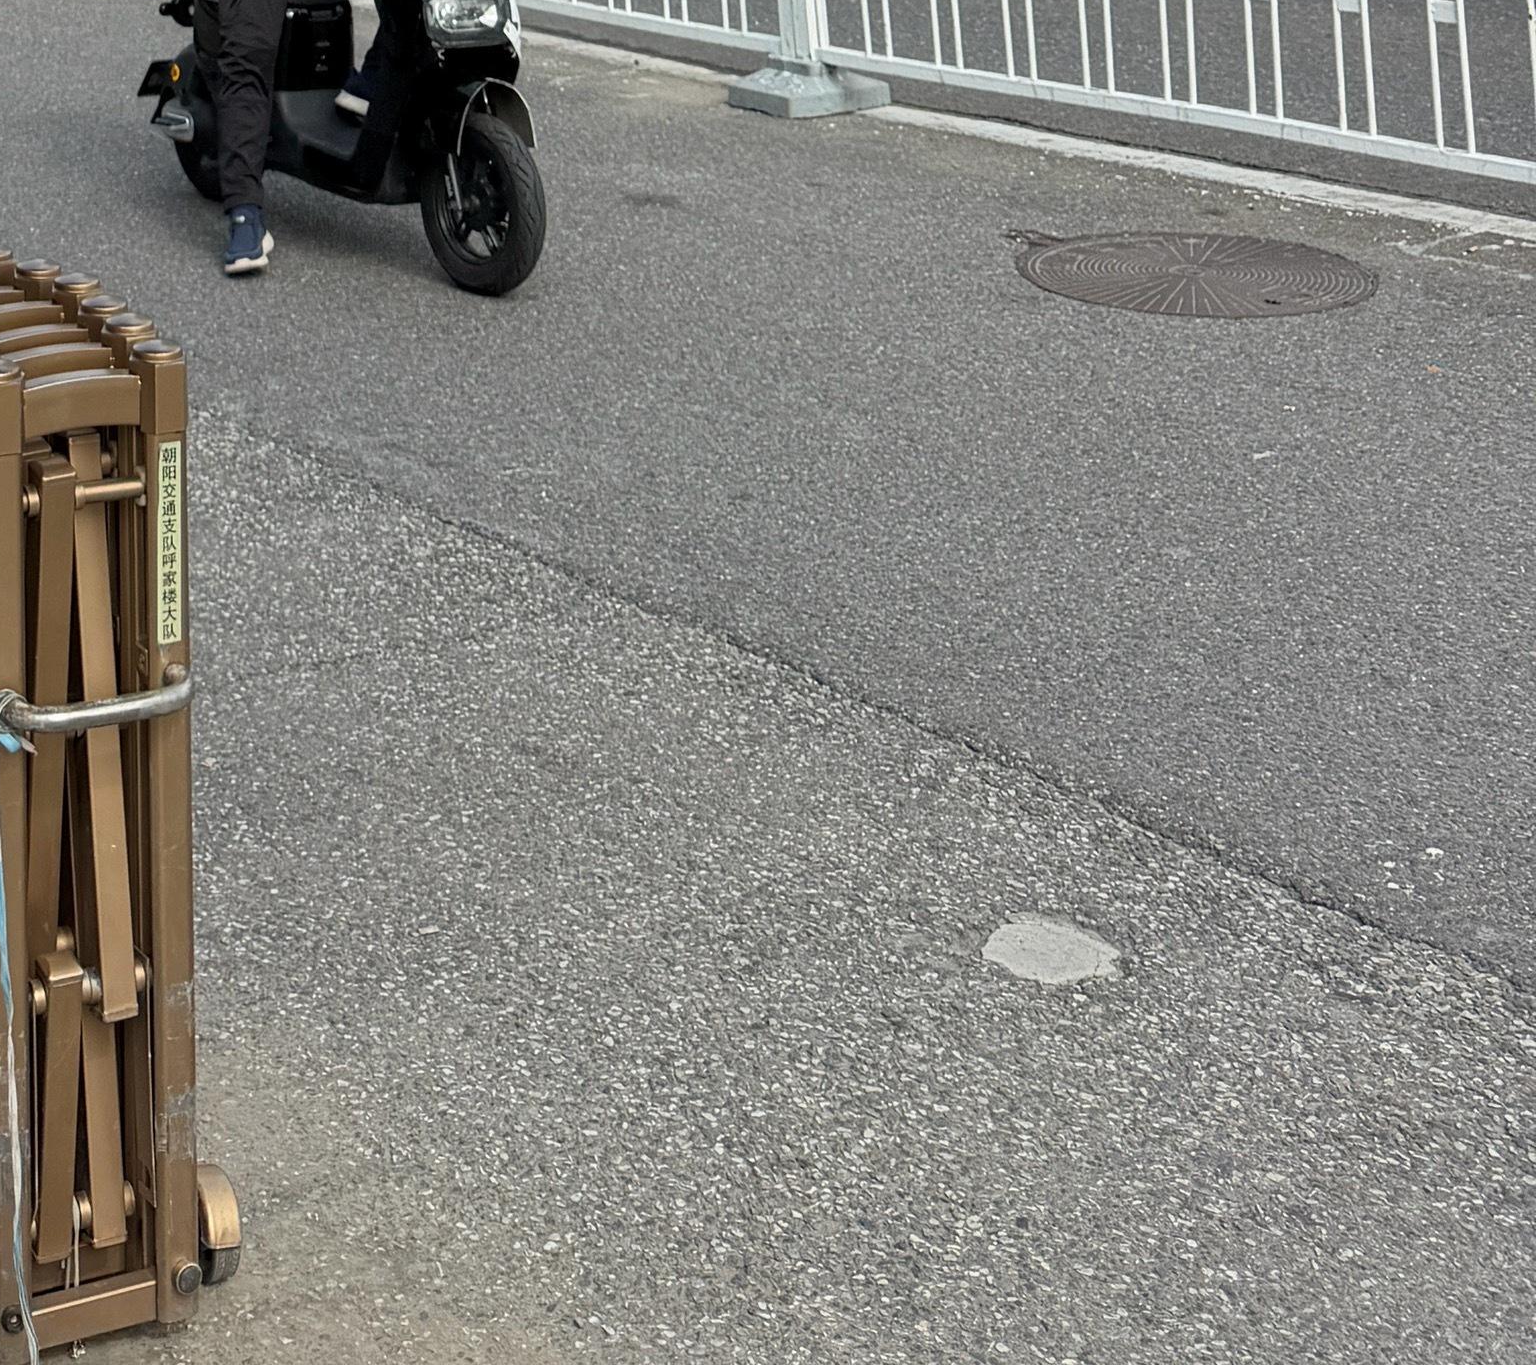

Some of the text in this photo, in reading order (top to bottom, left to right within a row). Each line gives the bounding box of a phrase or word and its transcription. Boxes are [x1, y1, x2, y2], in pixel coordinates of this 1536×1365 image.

[161, 447, 178, 640] 朝阳交通支队呼家楼大队
